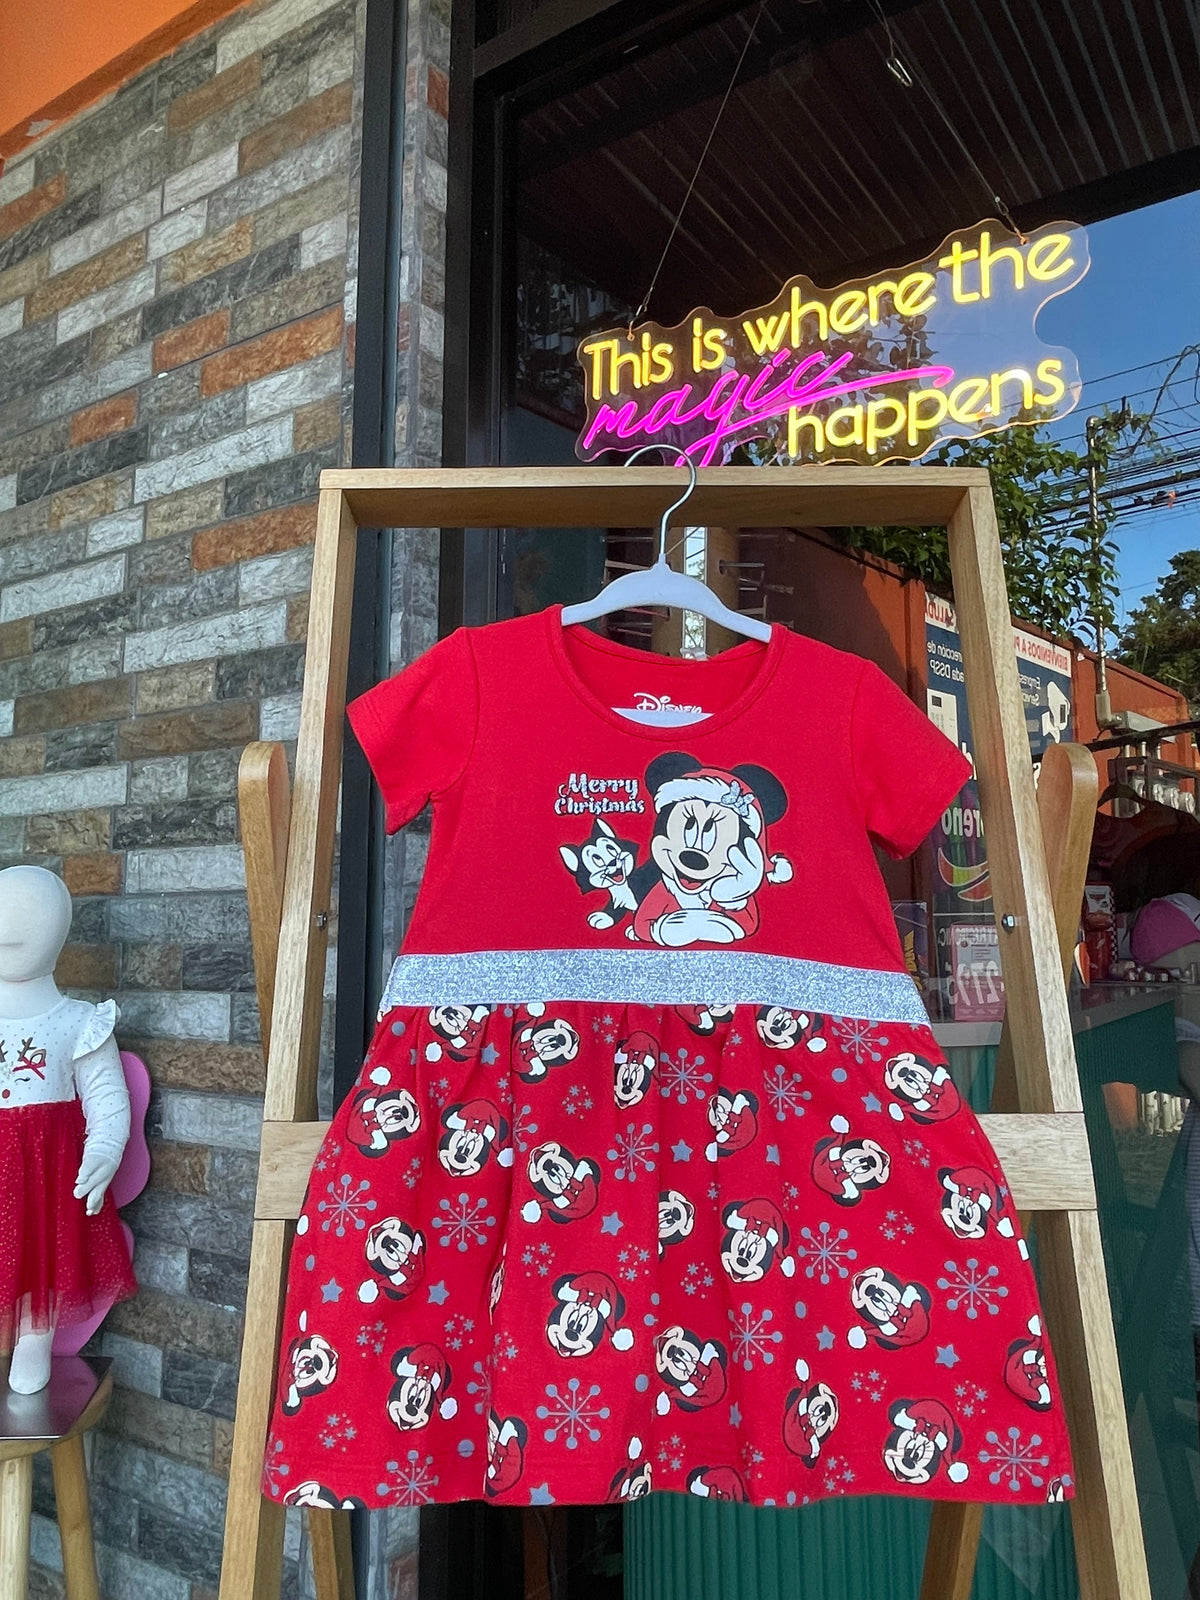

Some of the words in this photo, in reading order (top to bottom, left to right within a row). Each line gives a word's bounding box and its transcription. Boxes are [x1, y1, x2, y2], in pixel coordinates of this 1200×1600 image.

[583, 332, 673, 401] This
[692, 317, 728, 374] is
[742, 270, 937, 355] where
[938, 230, 1076, 305] the
[583, 347, 955, 467] magic
[786, 356, 1066, 458] happens
[554, 797, 645, 815] Christmas
[558, 773, 638, 800] Merry
